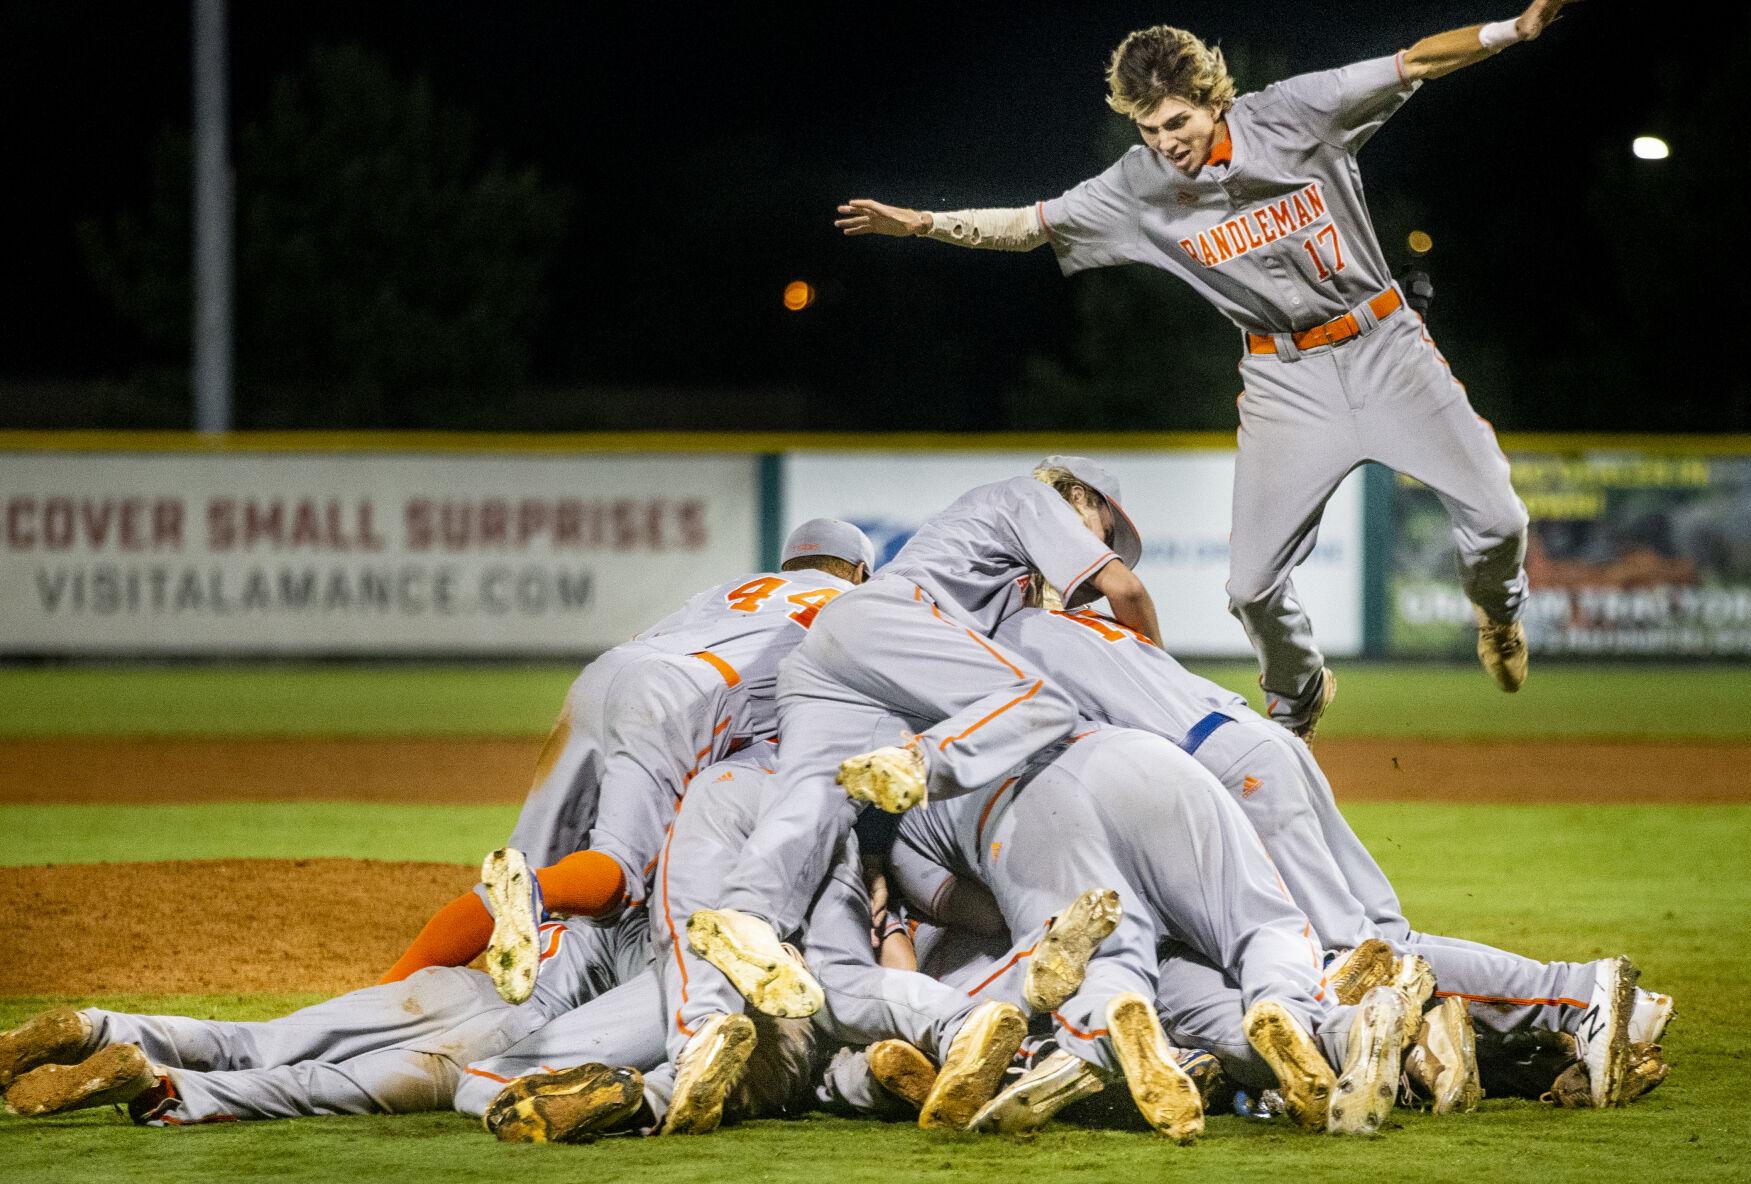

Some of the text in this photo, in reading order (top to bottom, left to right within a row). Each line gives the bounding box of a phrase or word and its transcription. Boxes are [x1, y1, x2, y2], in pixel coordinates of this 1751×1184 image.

[1178, 182, 1327, 268] RANDLEMAN
[1302, 222, 1346, 283] 17
[4, 497, 706, 551] COVER SMALL SURPRISES
[35, 567, 594, 613] VISITALAMANCE.COM
[725, 576, 845, 630] 44
